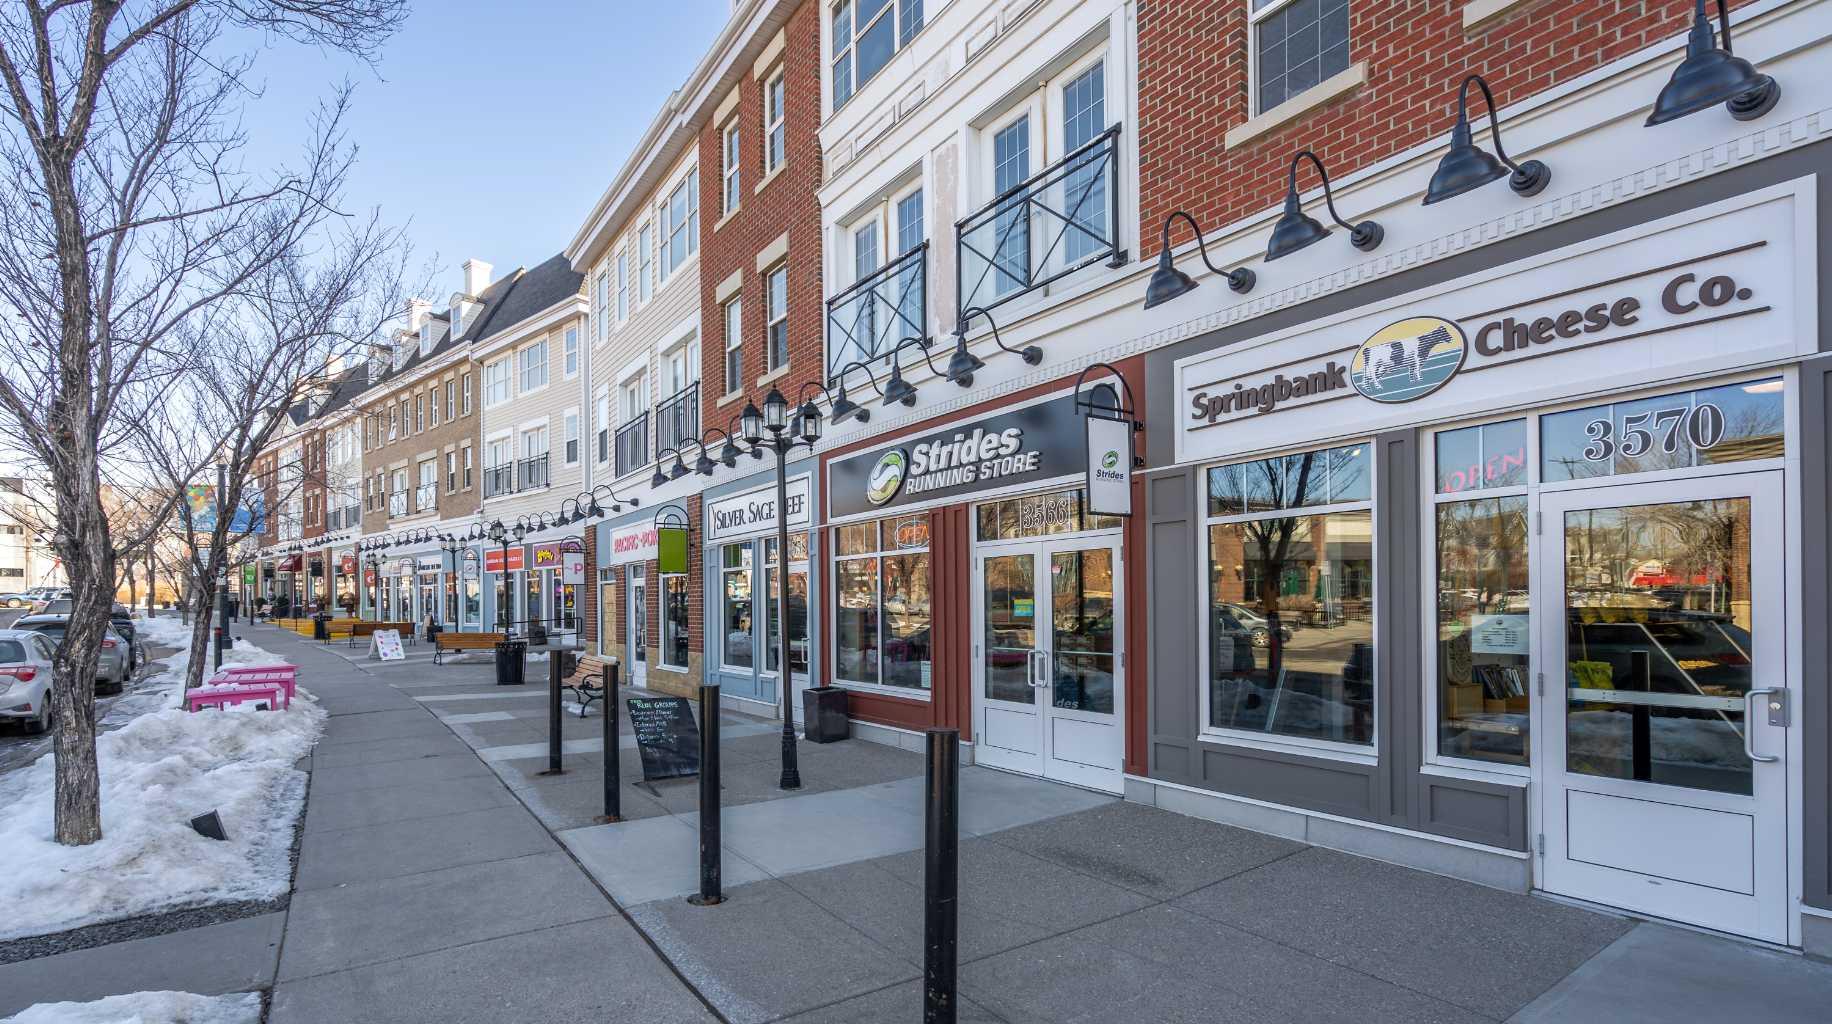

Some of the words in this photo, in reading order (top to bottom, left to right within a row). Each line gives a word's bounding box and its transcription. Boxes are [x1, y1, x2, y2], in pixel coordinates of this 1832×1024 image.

[1191, 361, 1348, 423] Springbank
[1474, 296, 1641, 357] Cheese
[1661, 272, 1753, 315] Co.
[910, 428, 1023, 475] Strides
[1583, 402, 1725, 462] 3570
[905, 465, 977, 495] RUNNING
[980, 450, 1041, 480] STORE
[1096, 469, 1124, 480] Strides
[1443, 447, 1524, 493] OPEN
[716, 507, 746, 530] SILVER
[748, 500, 775, 523] SAGE
[786, 493, 805, 515] EEF
[898, 523, 928, 545] OPEN
[1023, 497, 1068, 528] 3566
